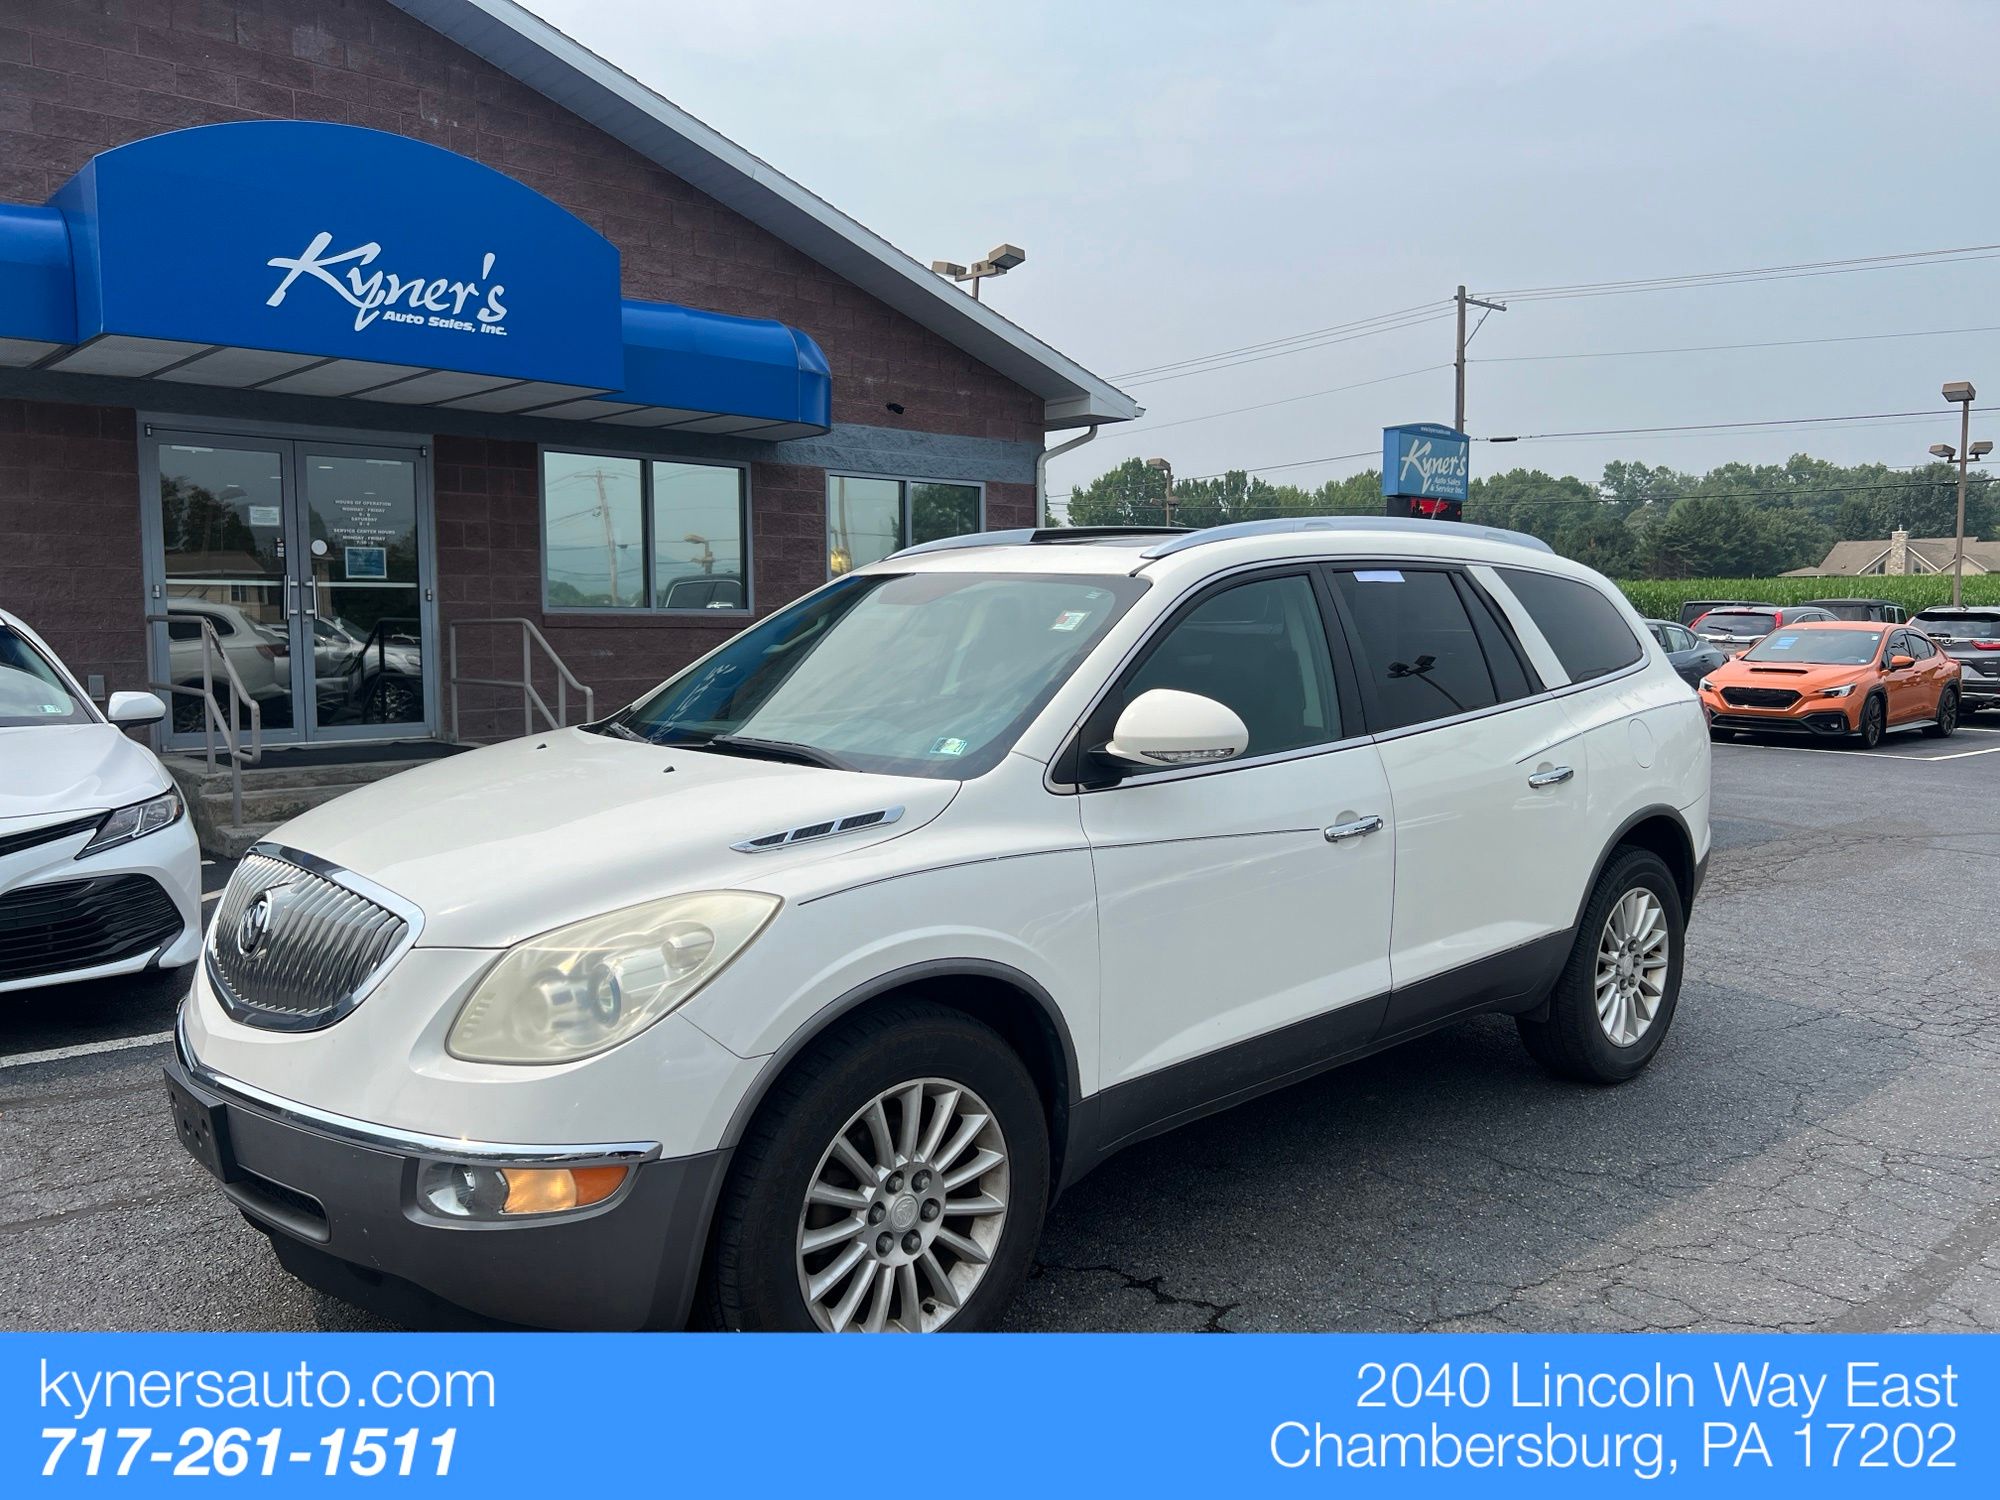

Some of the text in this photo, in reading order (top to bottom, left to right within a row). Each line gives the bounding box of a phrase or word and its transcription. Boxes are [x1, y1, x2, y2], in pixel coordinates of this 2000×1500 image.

[266, 231, 508, 332] Kyner's
[383, 310, 508, 336] Auto Sales, Inc.
[1400, 439, 1466, 494] Kyner's
